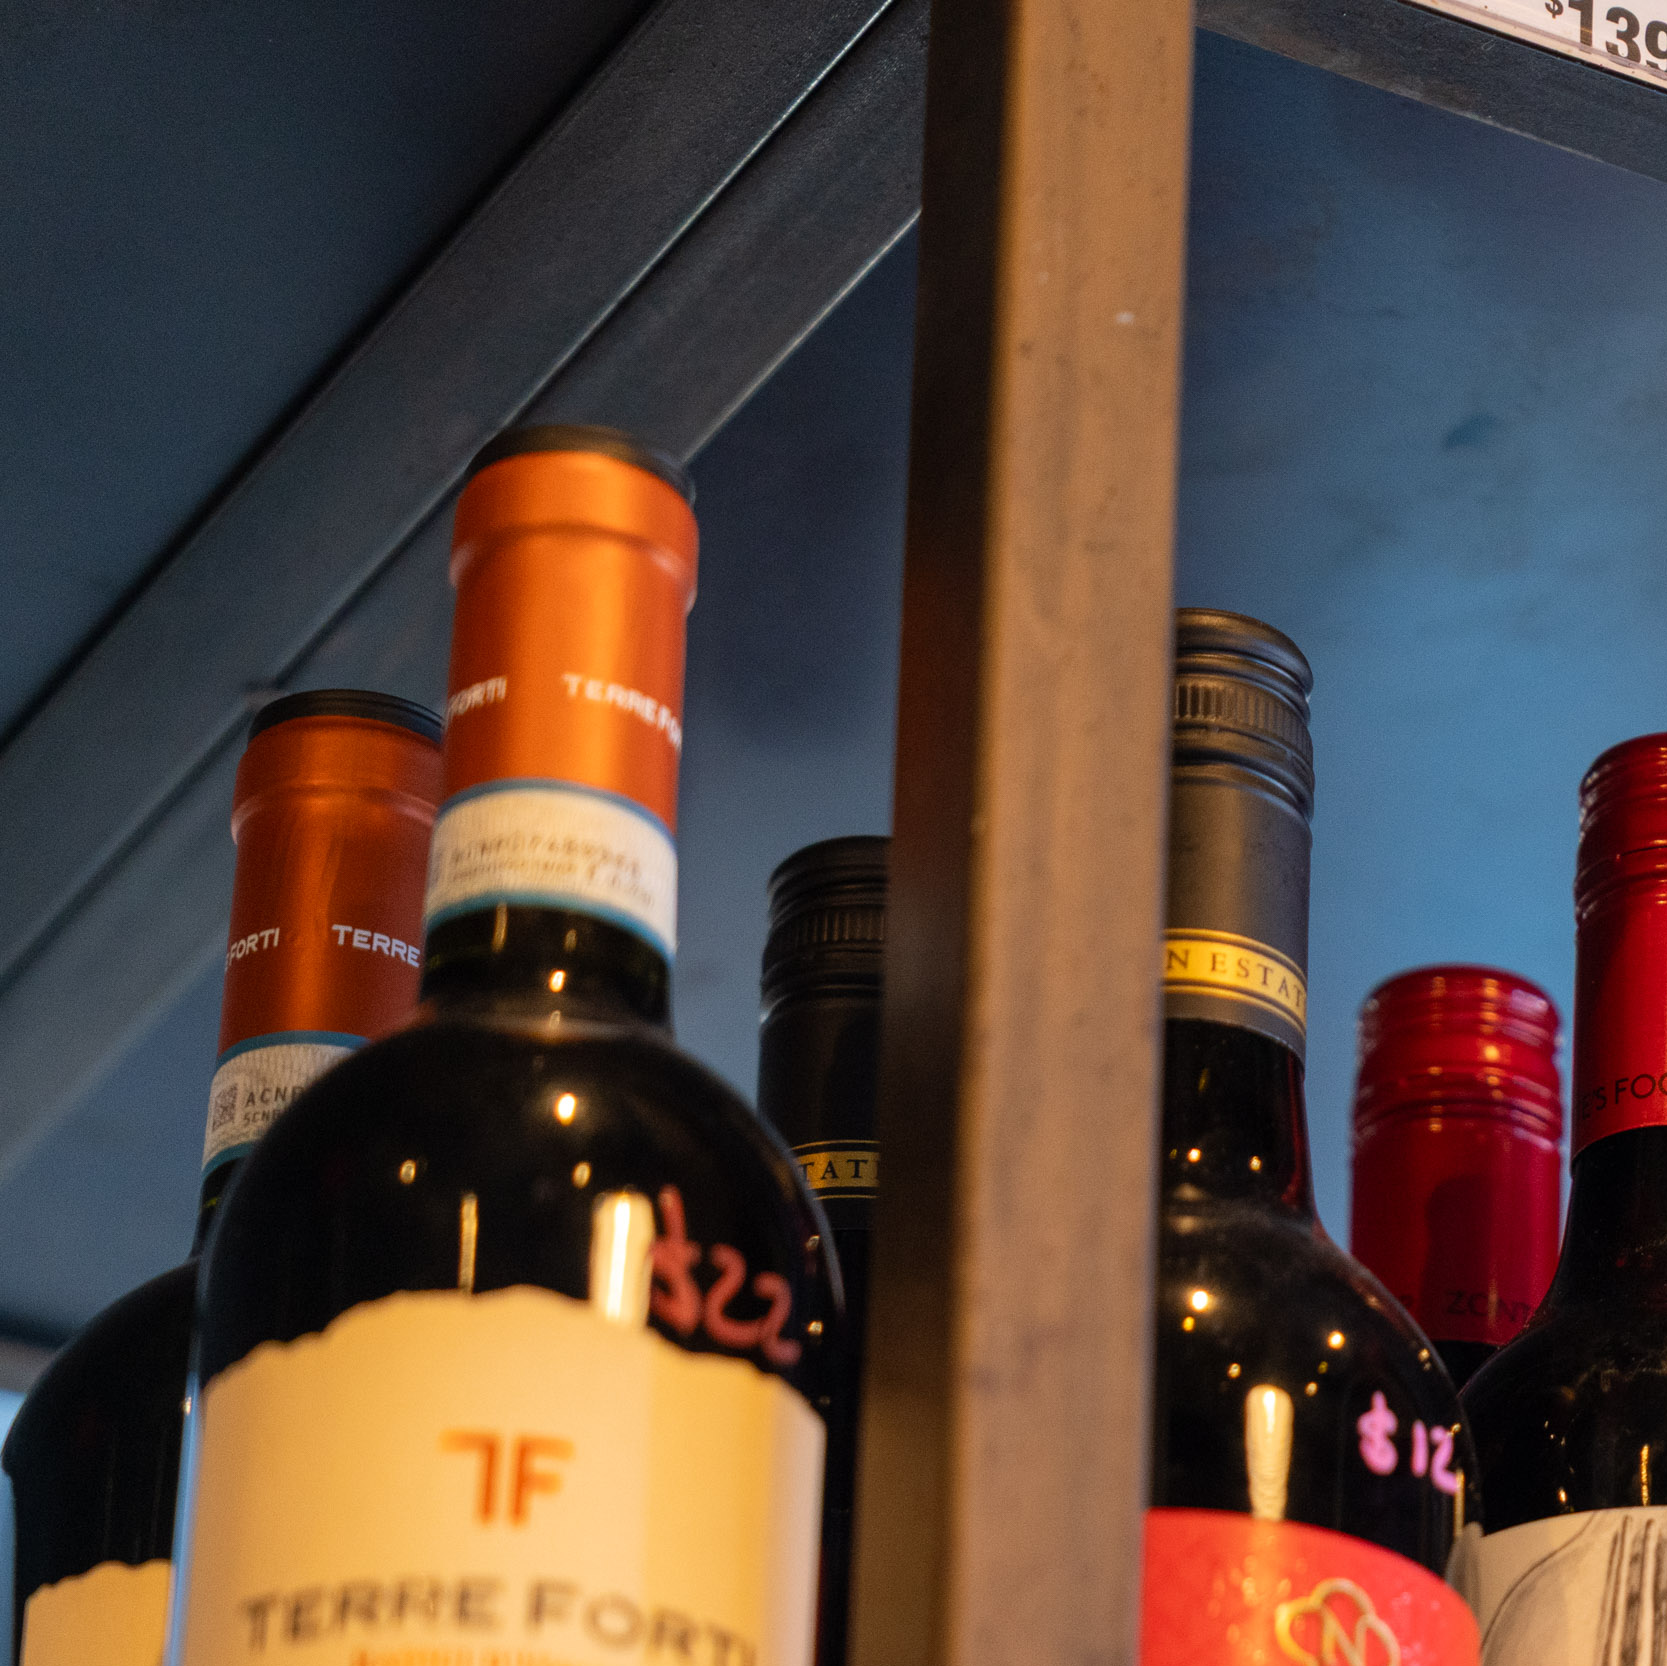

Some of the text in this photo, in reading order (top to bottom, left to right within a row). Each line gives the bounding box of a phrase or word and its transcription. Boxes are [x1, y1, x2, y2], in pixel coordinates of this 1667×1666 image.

[332, 924, 420, 968] TERRE
[1210, 951, 1304, 1008] ESTAT
[1357, 1389, 1461, 1496] $12
[240, 1574, 505, 1656] TERRE
